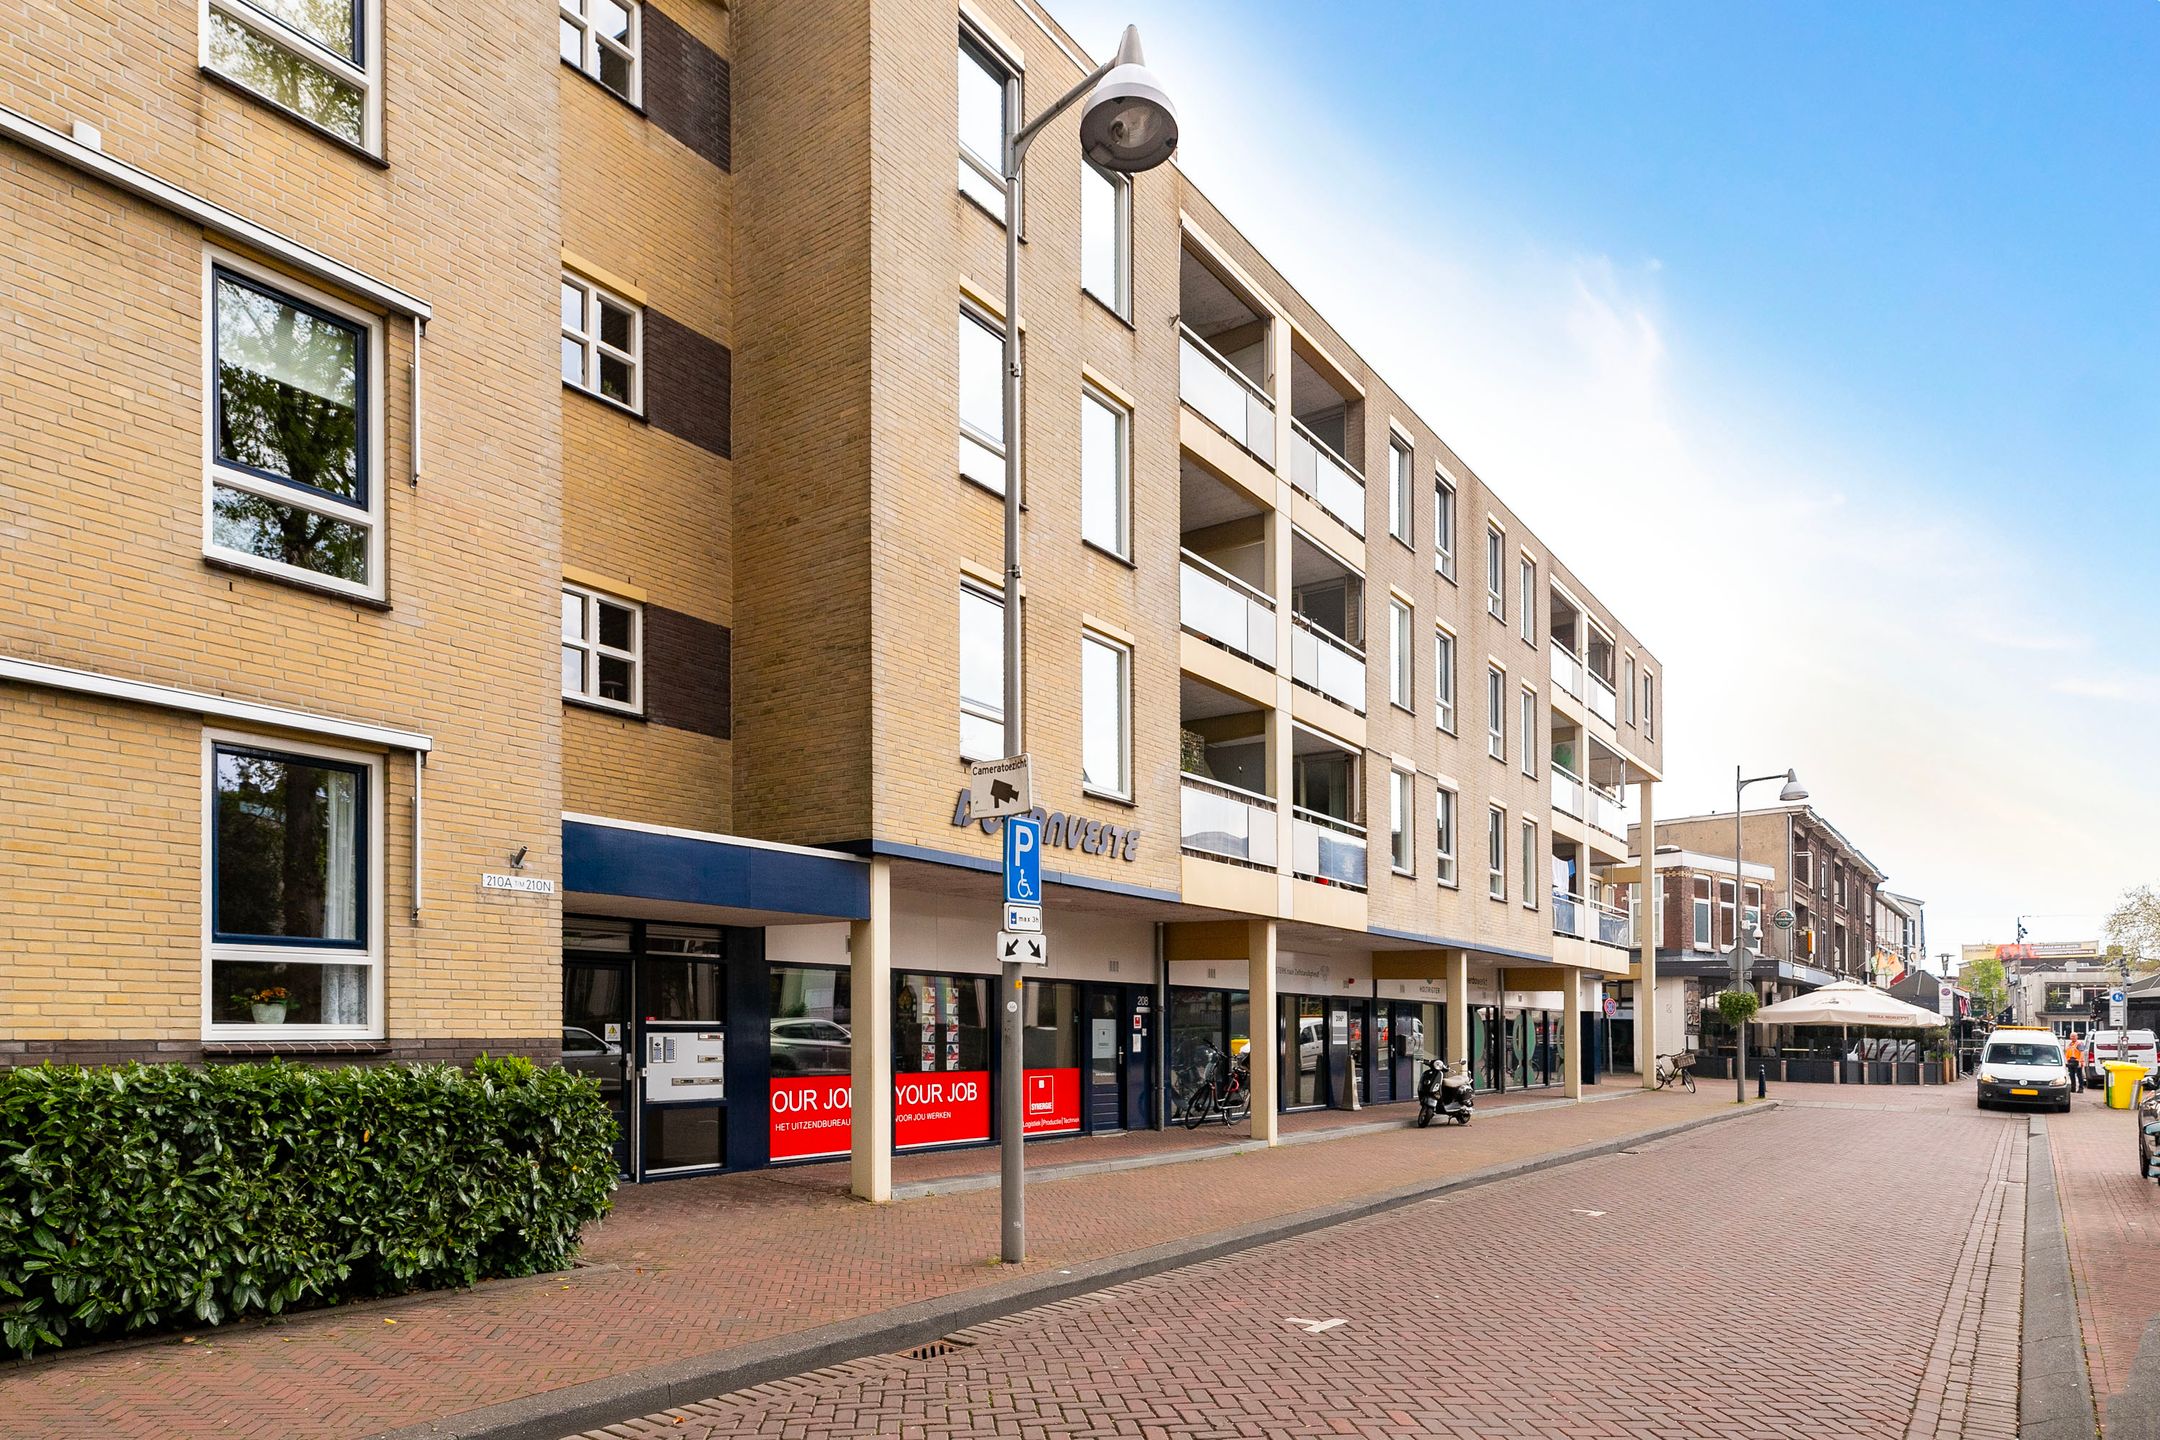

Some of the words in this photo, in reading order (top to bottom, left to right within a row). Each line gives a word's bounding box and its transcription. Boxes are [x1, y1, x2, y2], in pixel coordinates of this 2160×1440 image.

[972, 758, 1027, 776] Cameratoezicht
[1014, 824, 1034, 867] P
[486, 875, 513, 888] 210A
[526, 879, 551, 892] 210N
[1137, 996, 1149, 1006] 208
[772, 1089, 818, 1113] OUR
[895, 1083, 943, 1105] YOUR
[947, 1082, 978, 1102] JOB
[1031, 1102, 1053, 1111] SYNERGIE
[913, 1112, 926, 1121] JOU
[926, 1111, 952, 1120] WERKEN
[775, 1122, 790, 1132] HET
[791, 1118, 851, 1131] UITZENDBUREAU
